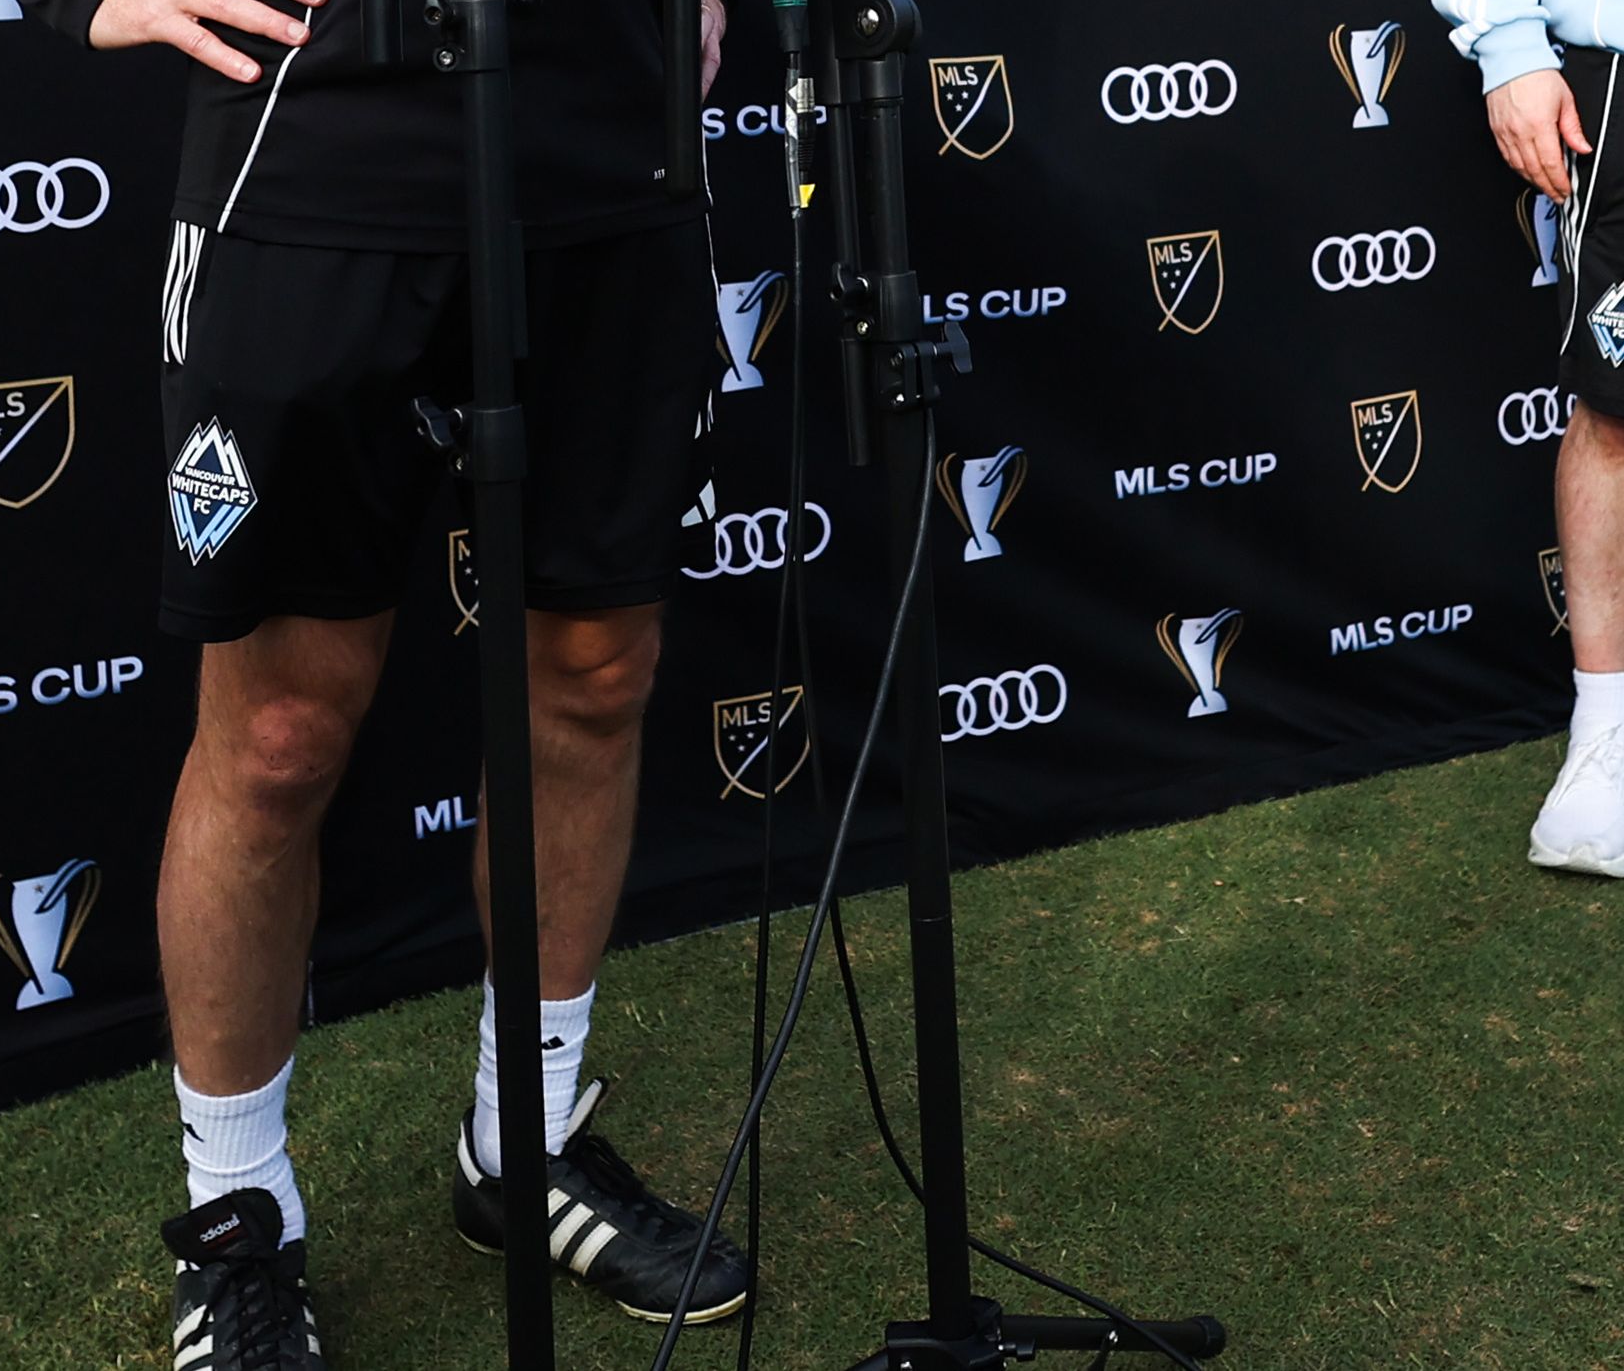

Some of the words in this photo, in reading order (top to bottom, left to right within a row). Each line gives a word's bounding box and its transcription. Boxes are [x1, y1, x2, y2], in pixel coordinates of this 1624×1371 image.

[937, 65, 979, 87] MLS
[1153, 241, 1193, 266] MLS
[923, 292, 970, 323] LS
[979, 286, 1067, 319] CUP
[1357, 402, 1394, 428] MLS
[172, 472, 250, 505] WHITECAPS
[185, 466, 236, 486] VANCOUVER
[1114, 463, 1190, 499] MLS
[1199, 452, 1277, 487] CUP
[193, 498, 212, 515] FC
[1330, 616, 1395, 655] MLS
[1400, 603, 1473, 639] CUP
[31, 655, 144, 704] CUP
[722, 701, 772, 729] MLS
[414, 795, 477, 839] ML
